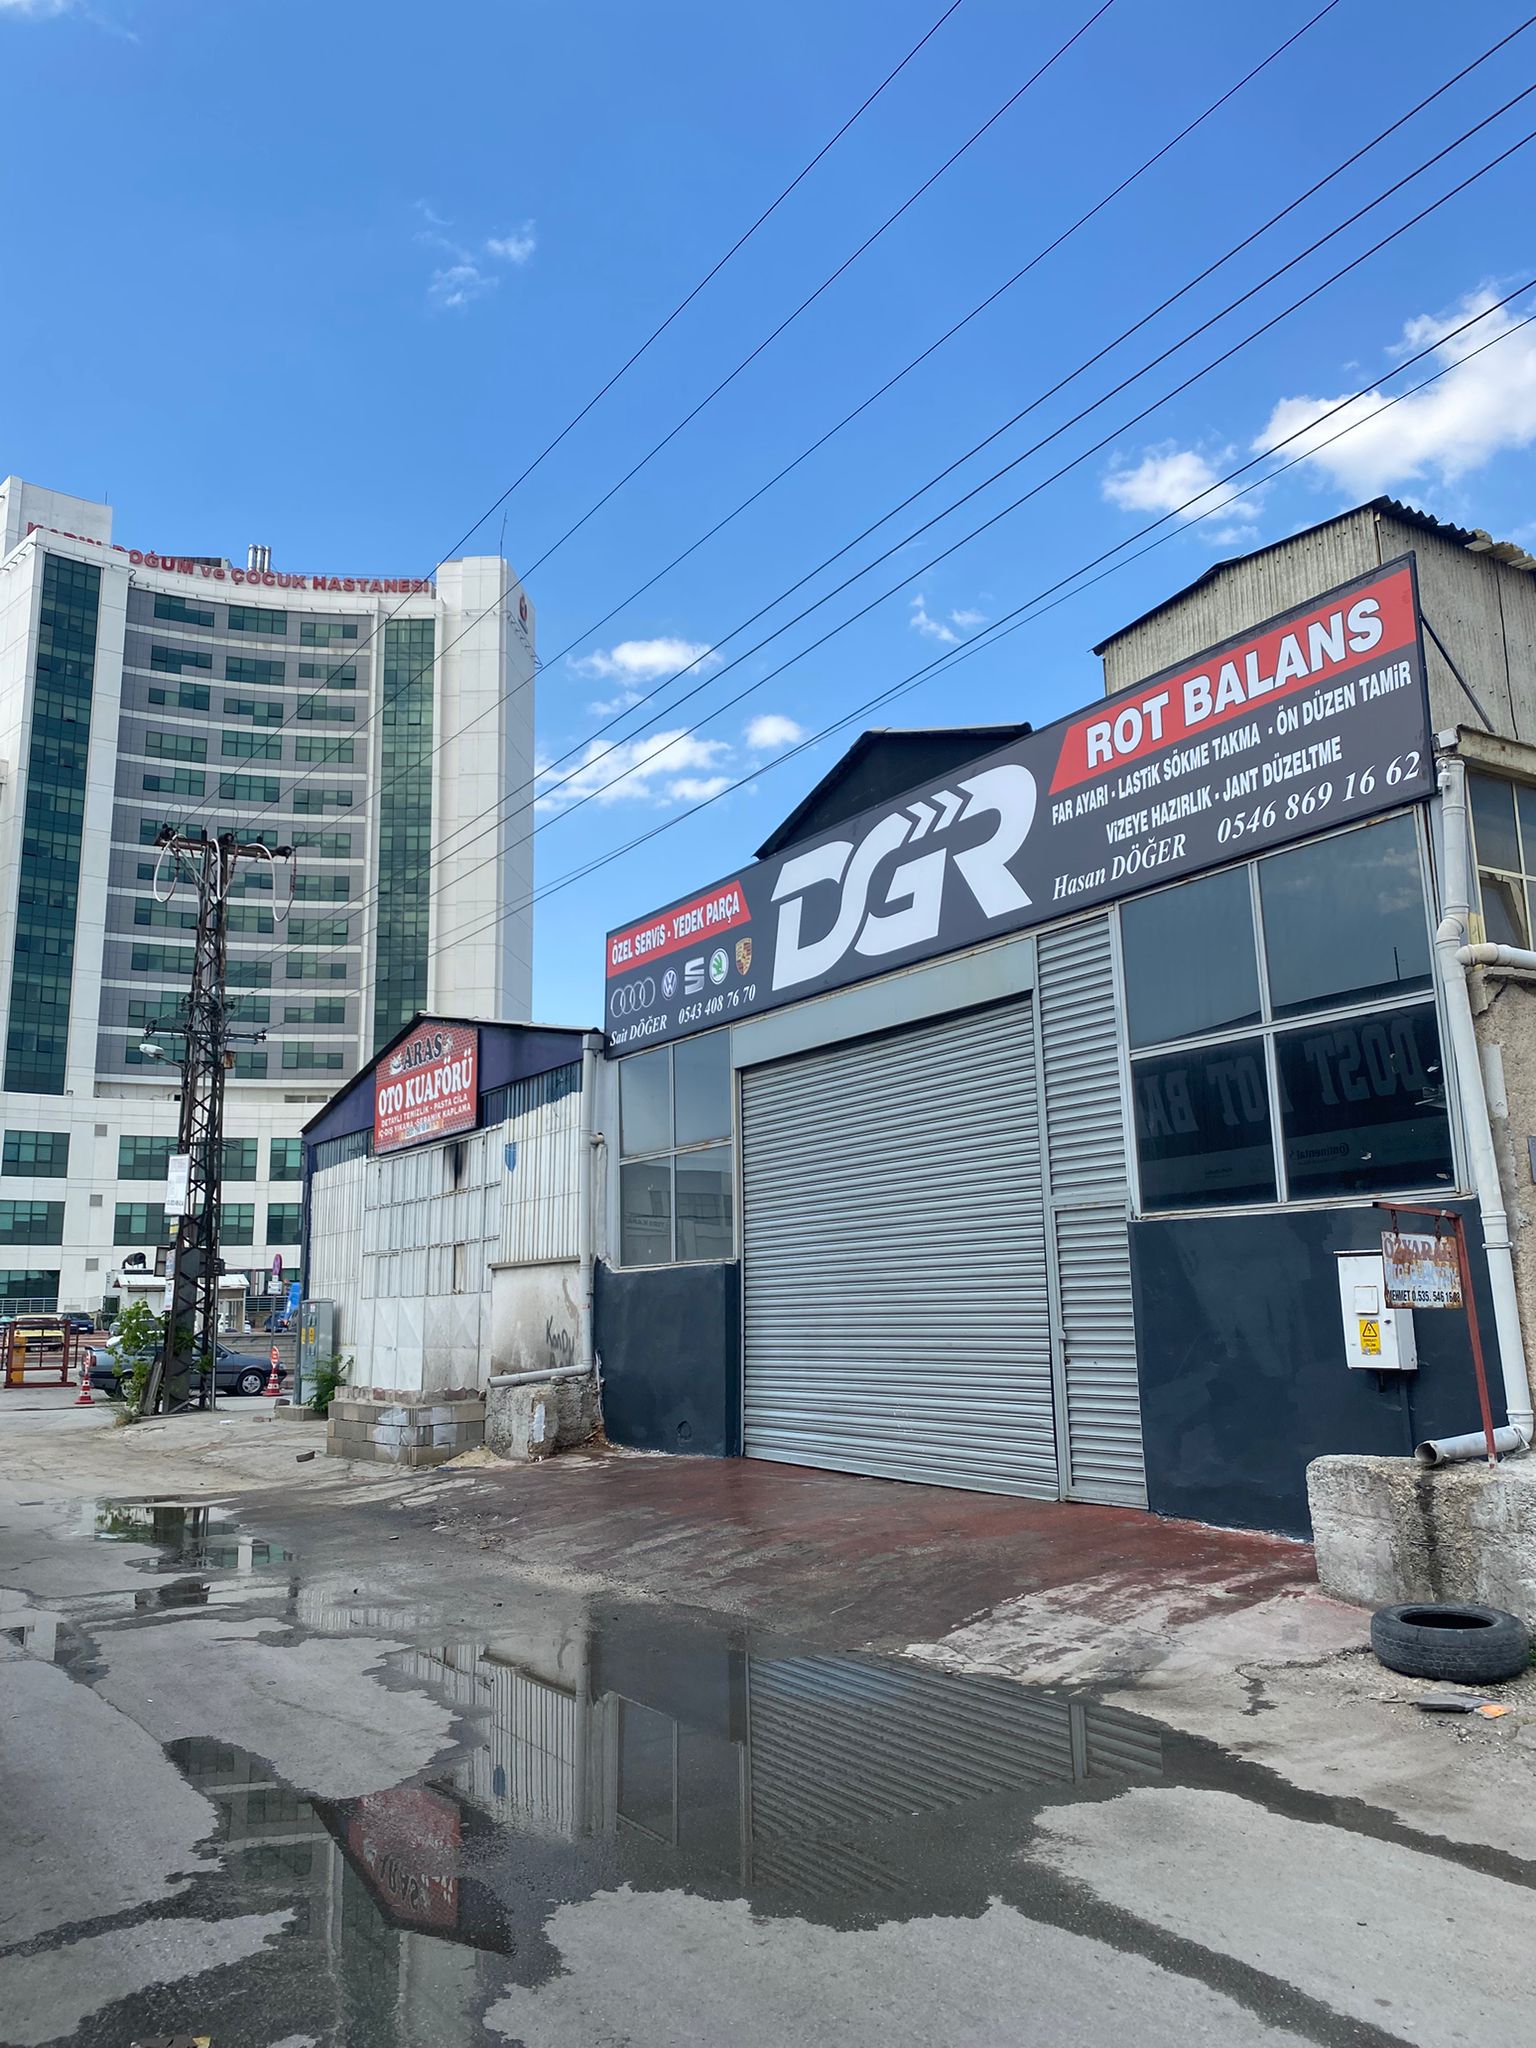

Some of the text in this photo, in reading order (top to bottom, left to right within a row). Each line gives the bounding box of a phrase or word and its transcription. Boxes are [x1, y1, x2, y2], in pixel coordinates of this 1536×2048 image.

[112, 544, 194, 575] OĞUM
[201, 565, 226, 581] ve
[230, 567, 306, 592] ÇOCUK
[1087, 597, 1384, 769] ROT BALANS
[1052, 798, 1074, 826] FAR
[1076, 783, 1109, 817] AYARI
[1162, 741, 1210, 778] SÖKME
[1211, 722, 1261, 761] TAKMA
[1276, 705, 1299, 736] ÖN
[1302, 680, 1356, 726] DÜZEN
[1151, 785, 1213, 829] HAZIRLIK
[1222, 766, 1260, 804] JANT
[1262, 735, 1343, 787] DÜZELTME
[1052, 749, 1421, 902] Hasan DÖĞER 0546 869 16 62
[770, 764, 1037, 993] DGR
[611, 938, 633, 966] ÖZEL
[672, 906, 705, 940] YEDEK
[706, 890, 740, 924] PARÇA
[402, 1032, 442, 1071] ARAS
[609, 984, 756, 1047] Sait DÖĞER 0543 408 76 70
[378, 1047, 473, 1117] OTO KUAFÖRÜ
